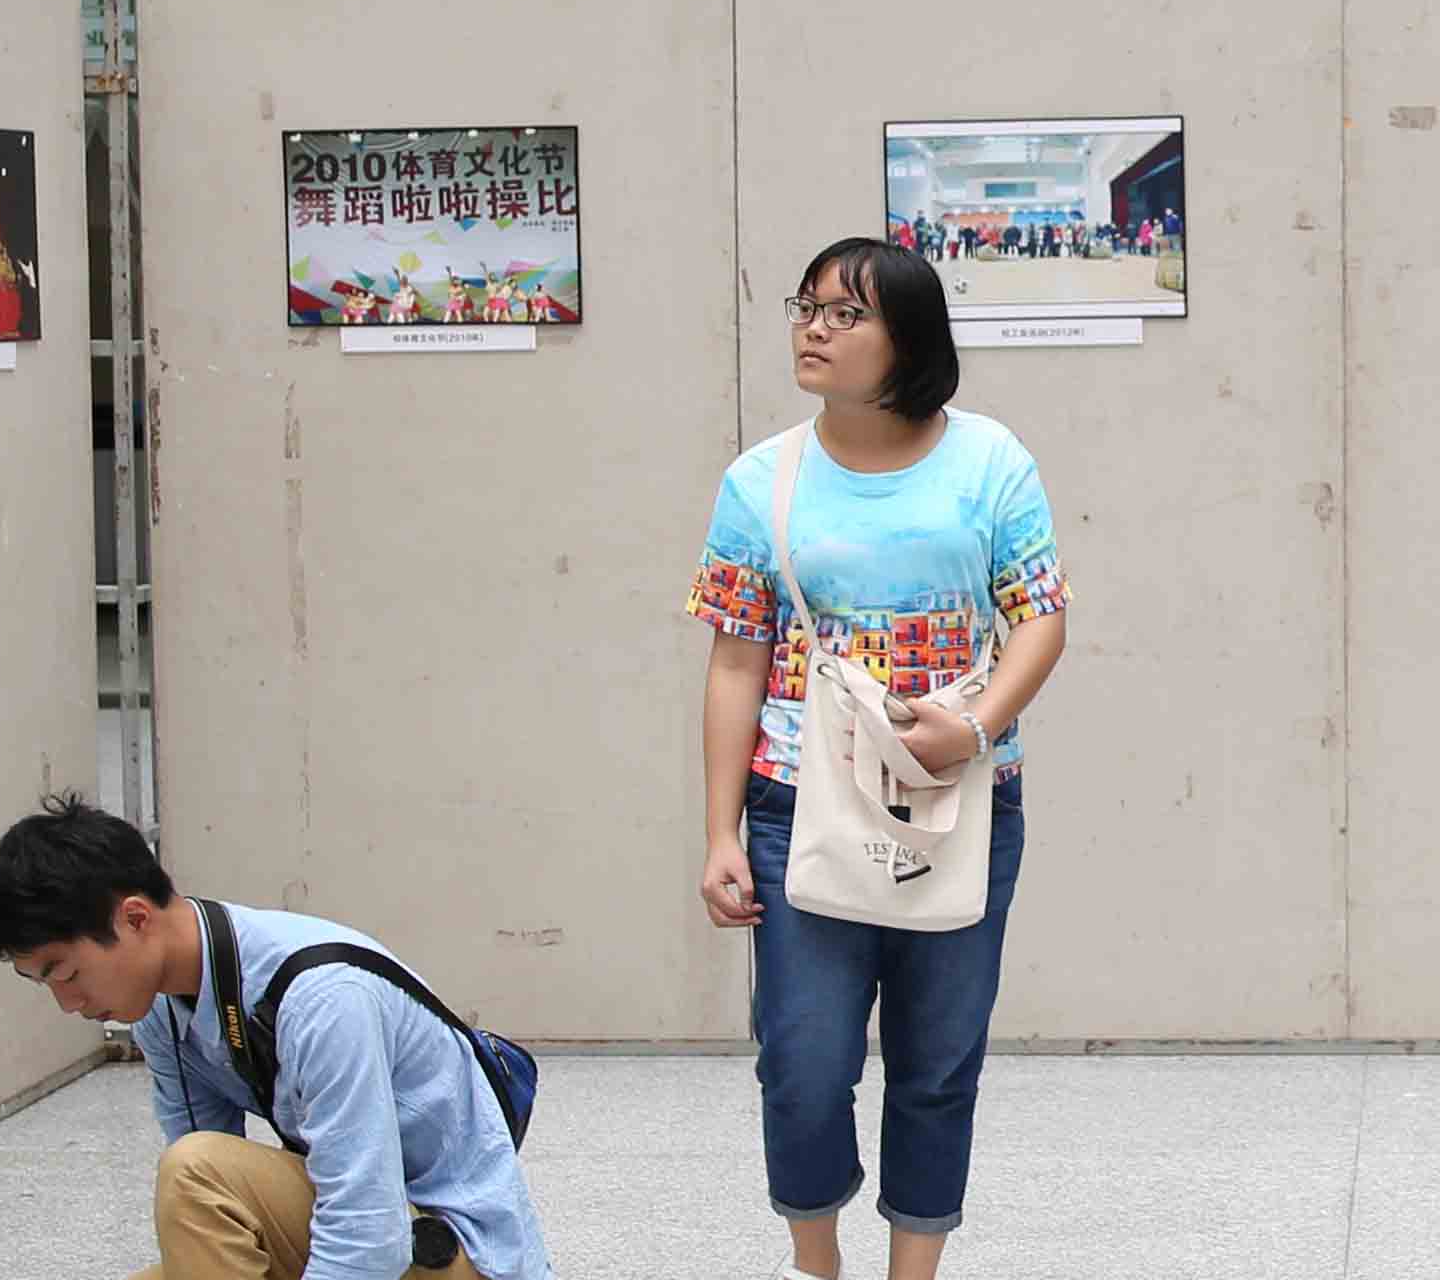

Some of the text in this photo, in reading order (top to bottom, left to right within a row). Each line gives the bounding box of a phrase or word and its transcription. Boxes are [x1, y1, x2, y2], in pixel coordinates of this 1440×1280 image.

[293, 178, 577, 227] 舞蹈啦啦操比
[226, 1004, 244, 1049] Nikon
